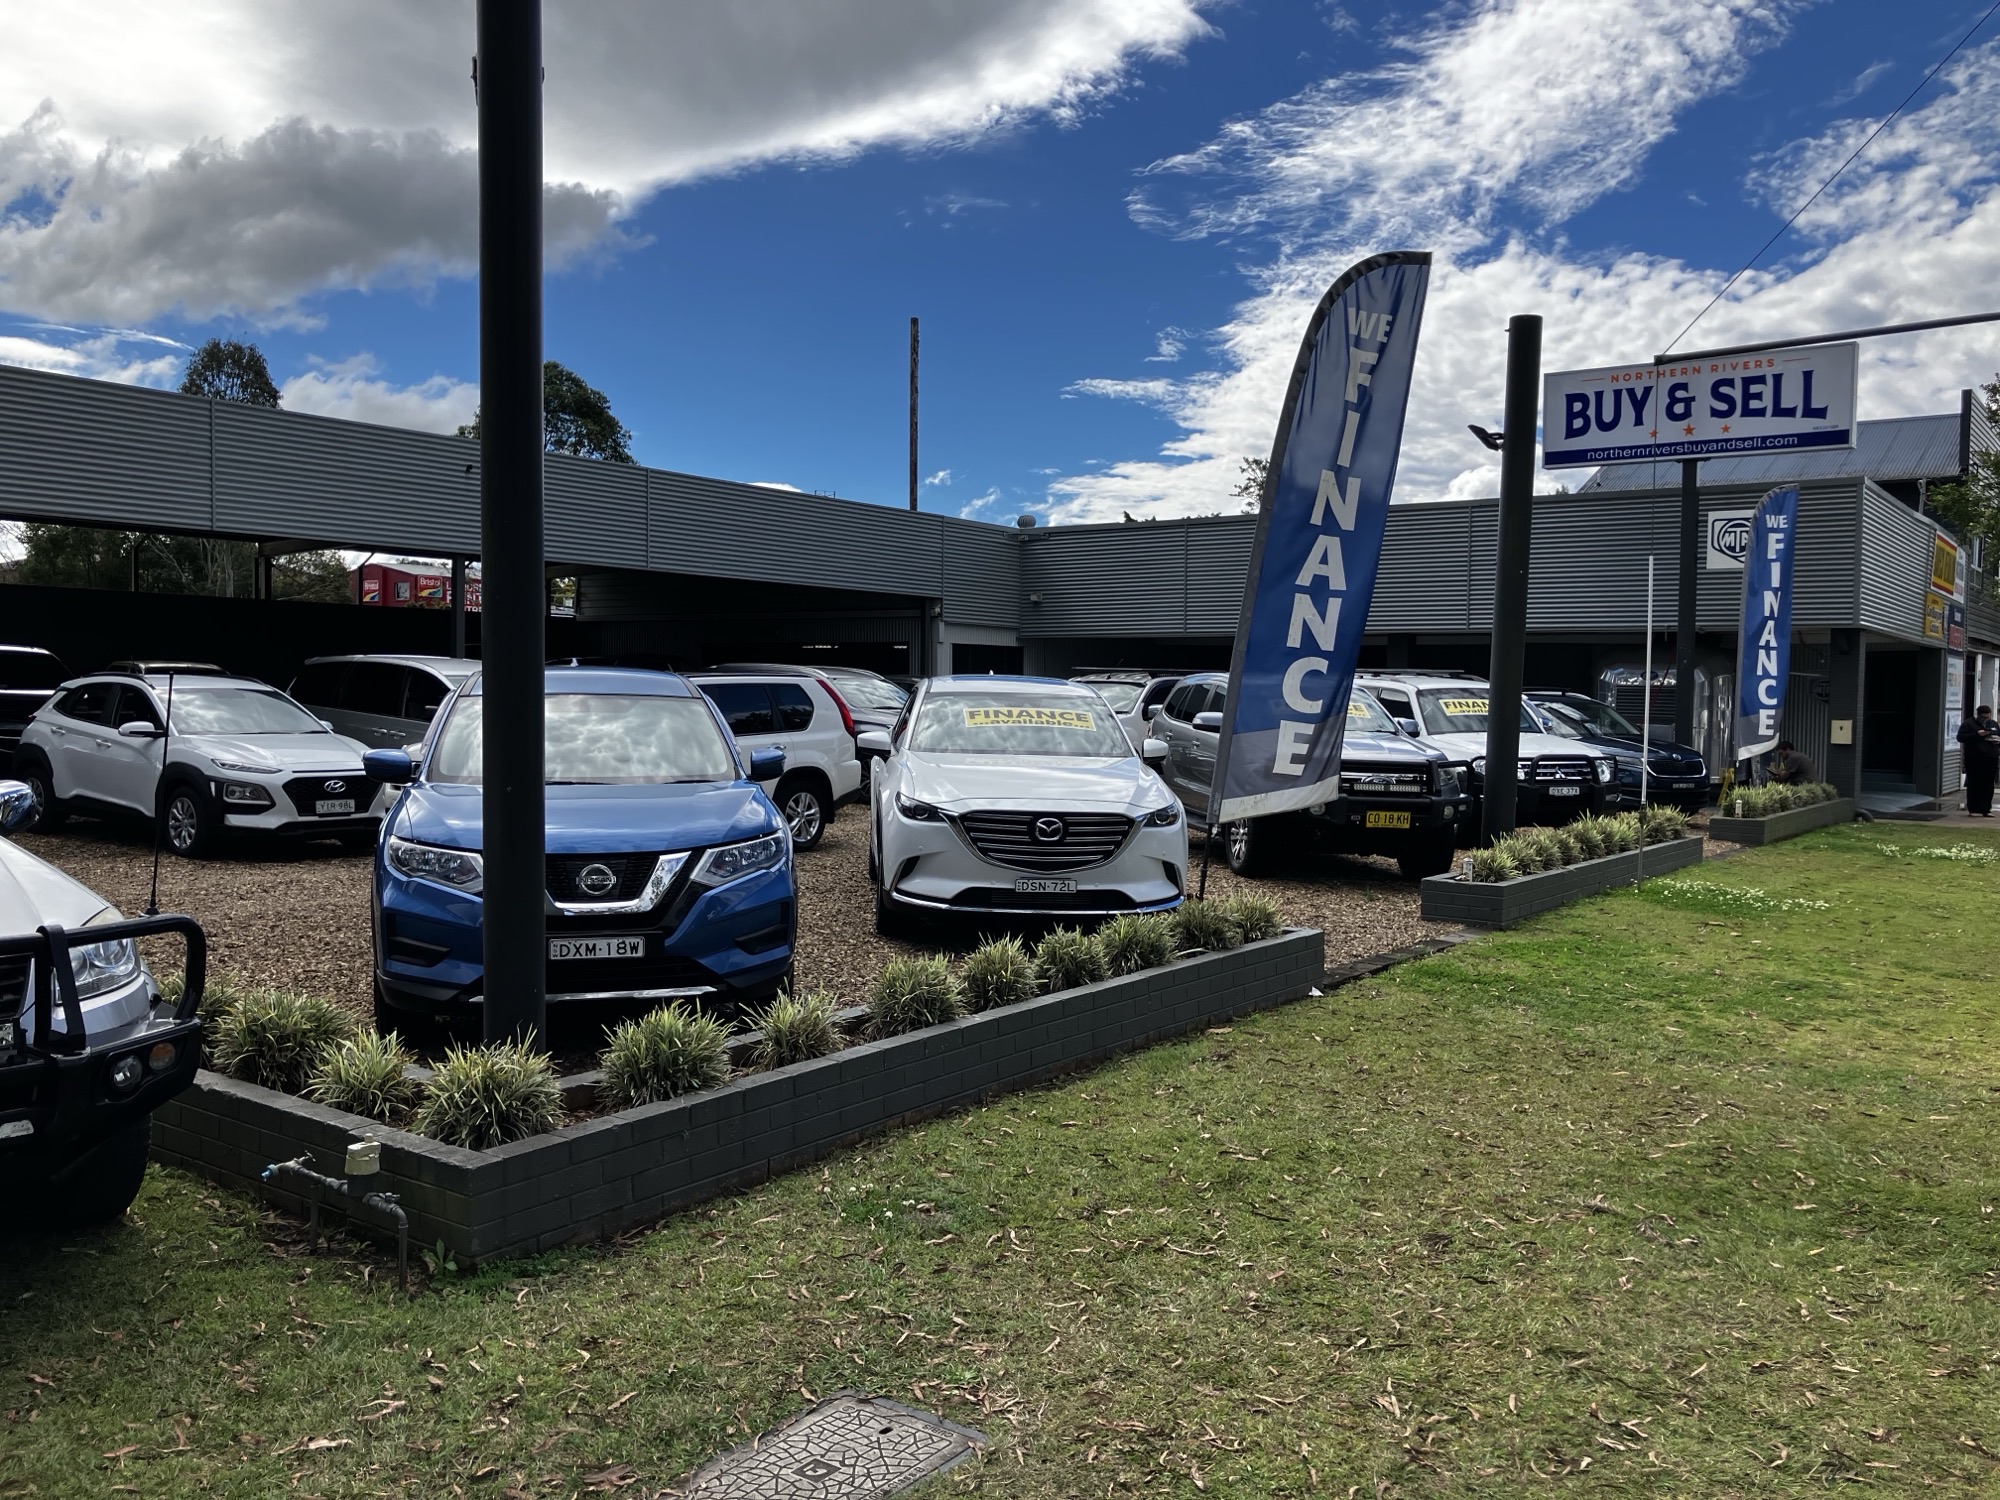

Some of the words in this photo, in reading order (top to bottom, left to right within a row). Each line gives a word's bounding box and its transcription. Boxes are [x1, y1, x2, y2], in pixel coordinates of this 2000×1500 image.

[1348, 307, 1393, 343] WE
[1610, 366, 1702, 384] NORTHERN
[1710, 358, 1776, 374] RIVERS
[1564, 385, 1655, 440] BUY
[1665, 382, 1696, 423] &
[1709, 369, 1829, 420] SELL
[1587, 434, 1799, 460] northernriversbuyandsell.com
[1765, 514, 1789, 529] WE
[1272, 346, 1379, 776] FINANCE
[420, 577, 441, 587] Bristol
[1756, 533, 1785, 736] FINANCE
[968, 709, 1090, 723] FINANCE
